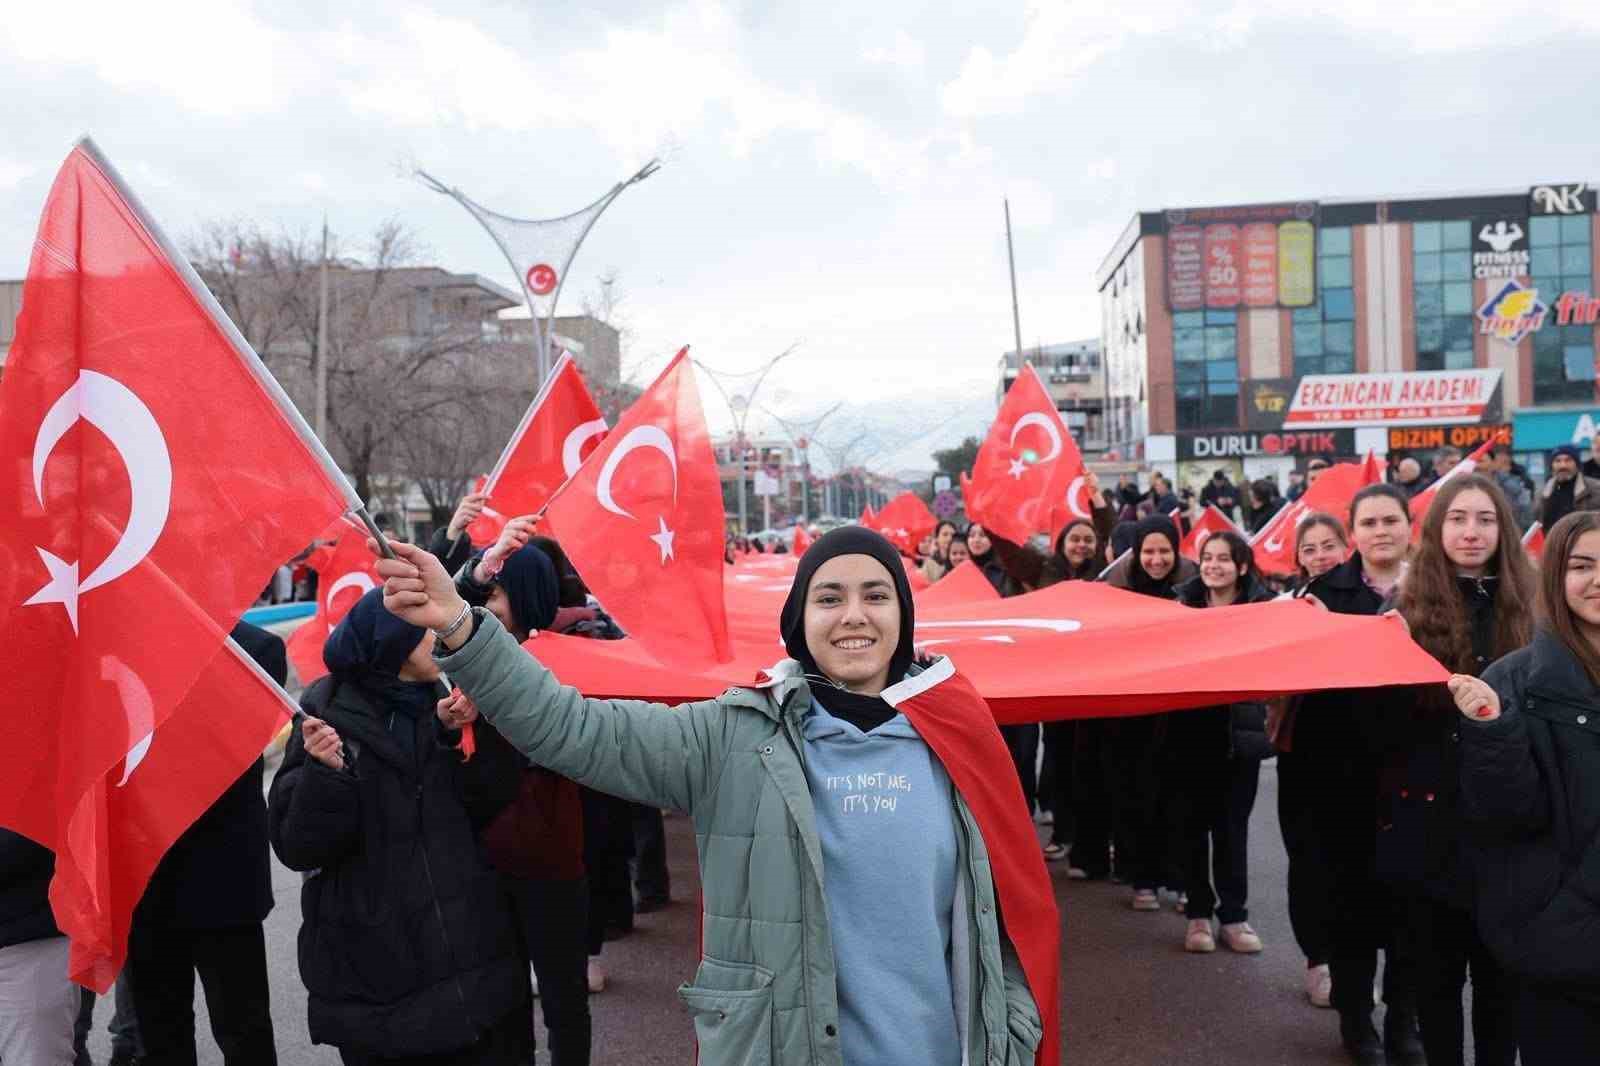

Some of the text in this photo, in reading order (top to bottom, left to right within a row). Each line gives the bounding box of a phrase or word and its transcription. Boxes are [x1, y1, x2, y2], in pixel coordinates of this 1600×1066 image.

[1533, 182, 1585, 213] NK
[1474, 250, 1529, 265] FITNESS
[1208, 266, 1239, 285] 50
[1475, 265, 1527, 279] CENTER
[1300, 379, 1393, 407] ERZİNCAN
[1193, 435, 1257, 456] DURU
[827, 776, 853, 791] IT'S
[888, 776, 911, 792] ME,
[842, 794, 869, 813] IT'S
